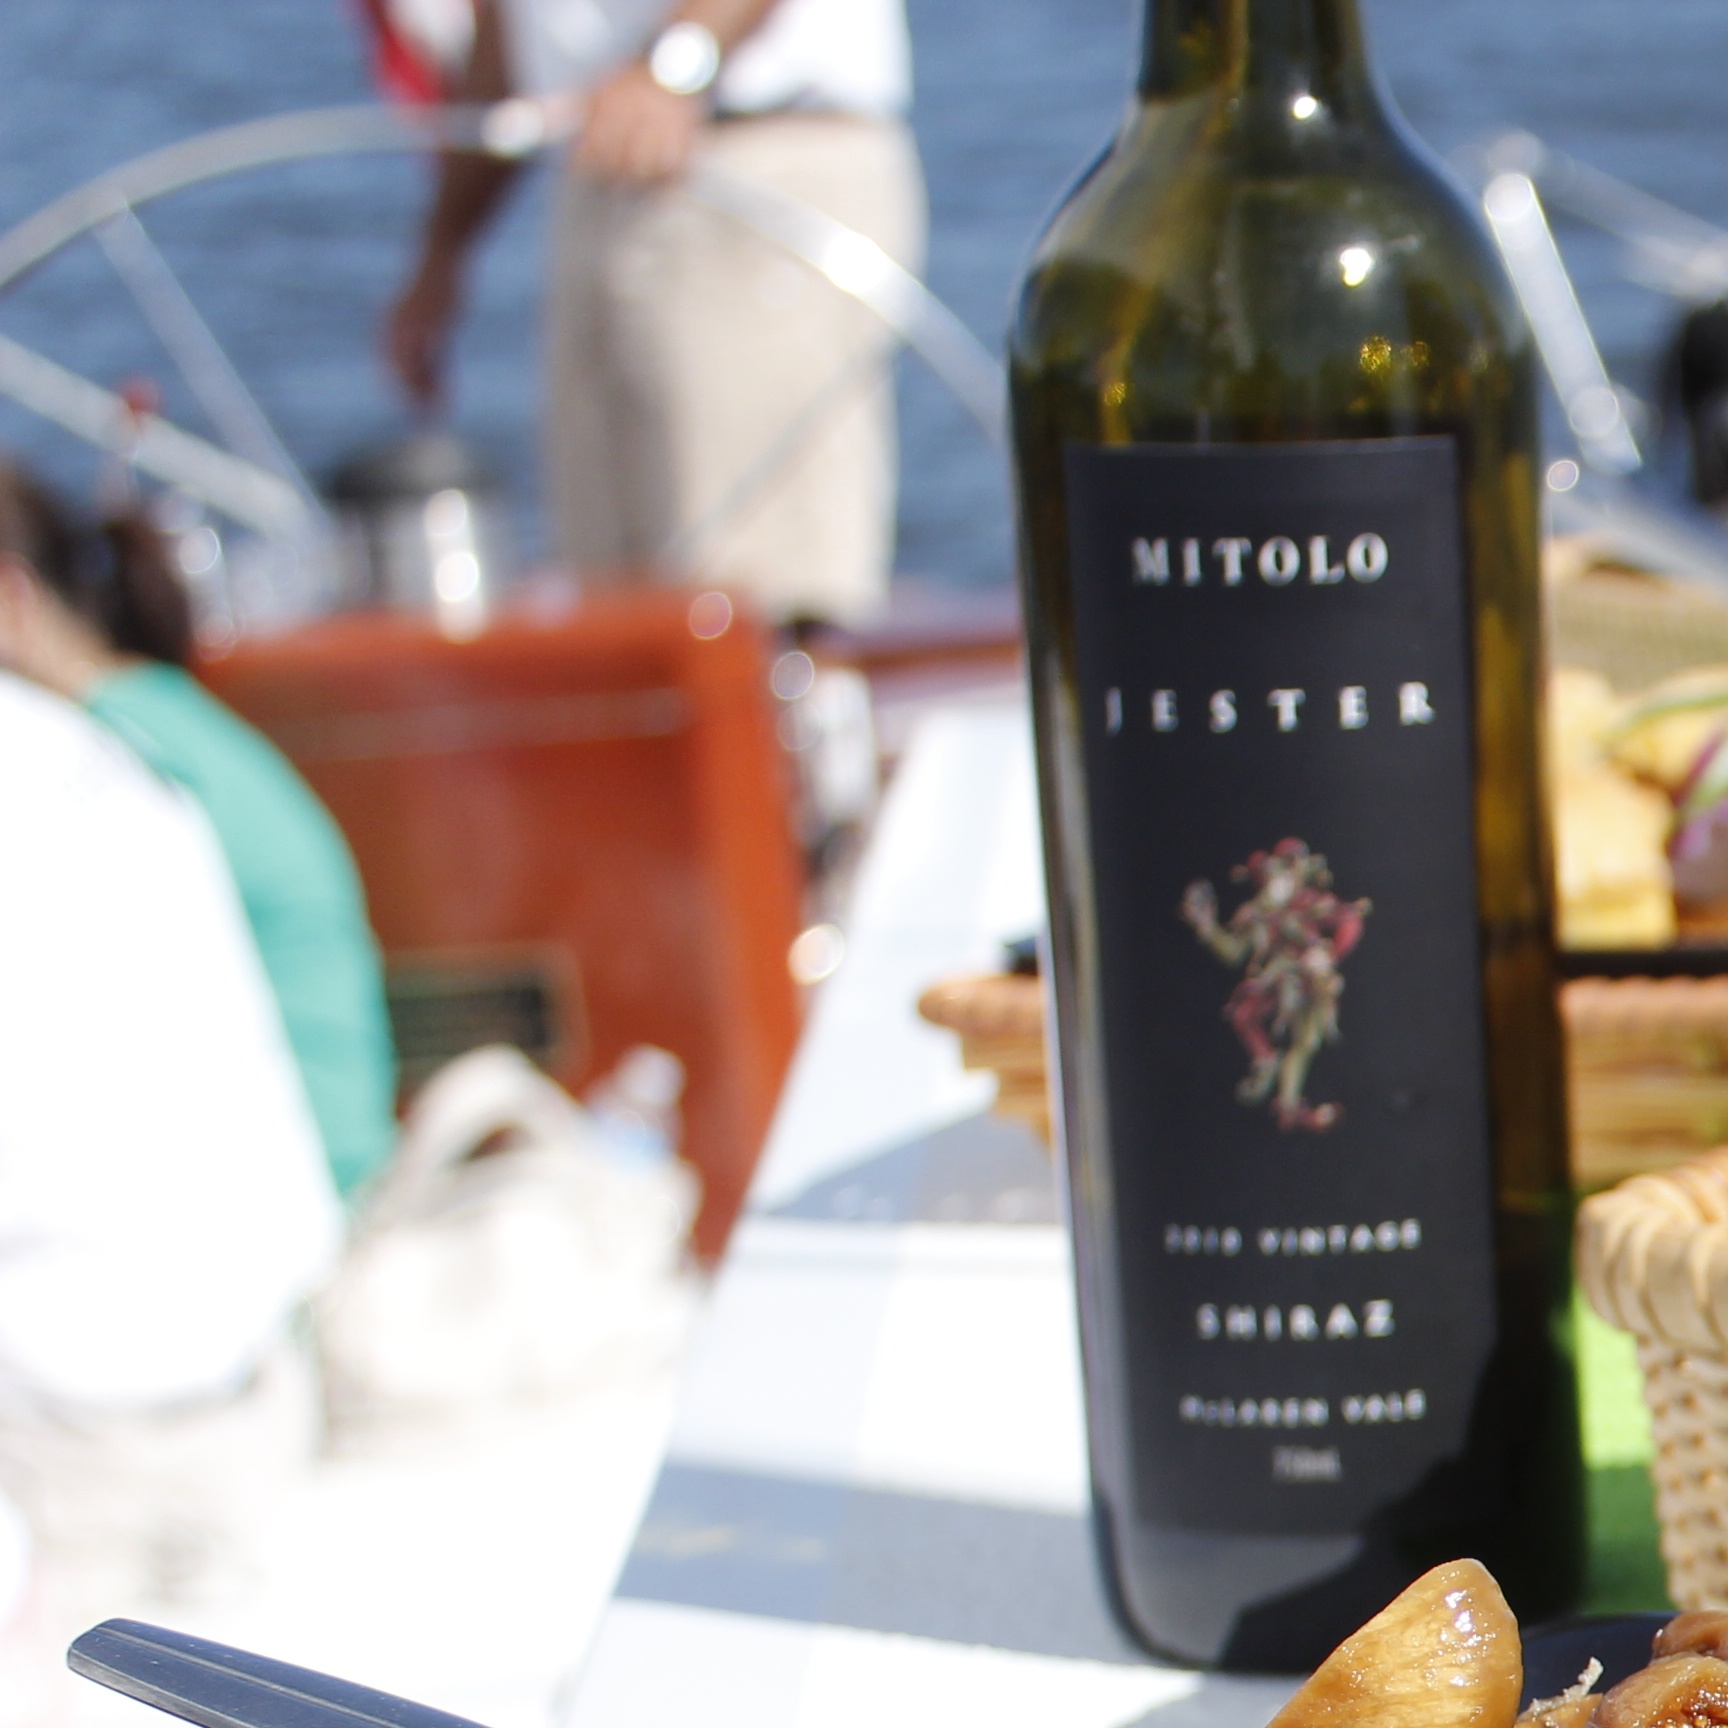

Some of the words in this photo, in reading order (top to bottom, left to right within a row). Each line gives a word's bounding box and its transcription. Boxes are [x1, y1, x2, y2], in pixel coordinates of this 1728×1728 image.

[1131, 532, 1389, 586] MITOLO
[1104, 681, 1436, 737] JESTER
[1257, 1218, 1422, 1258] VINTAGE
[1196, 1299, 1395, 1341] SHIRAZ
